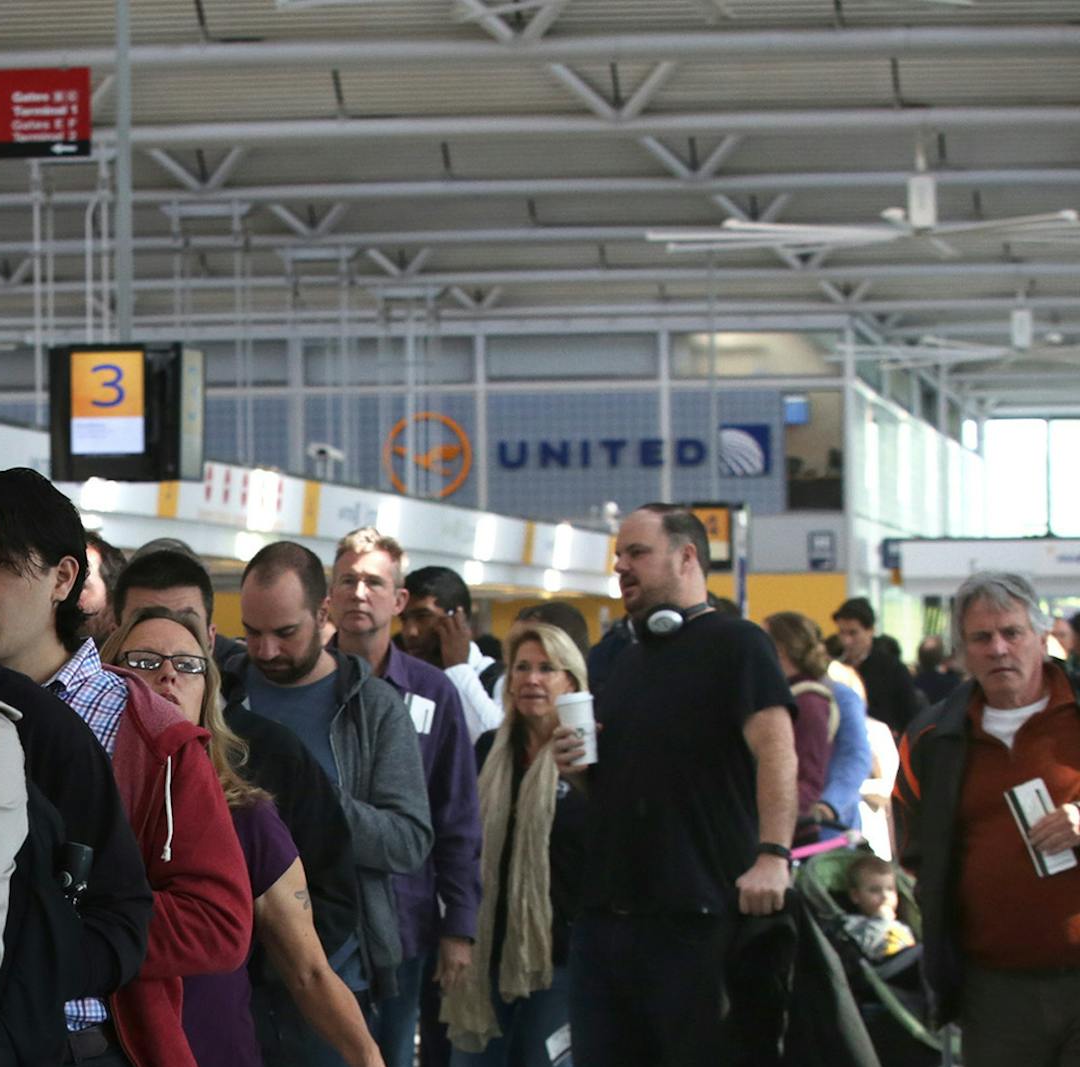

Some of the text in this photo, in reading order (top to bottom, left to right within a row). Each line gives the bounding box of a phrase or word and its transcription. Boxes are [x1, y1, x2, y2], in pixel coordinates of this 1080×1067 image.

[12, 104, 67, 117] Terminal
[89, 363, 126, 408] 3
[497, 438, 708, 470] UNITED
